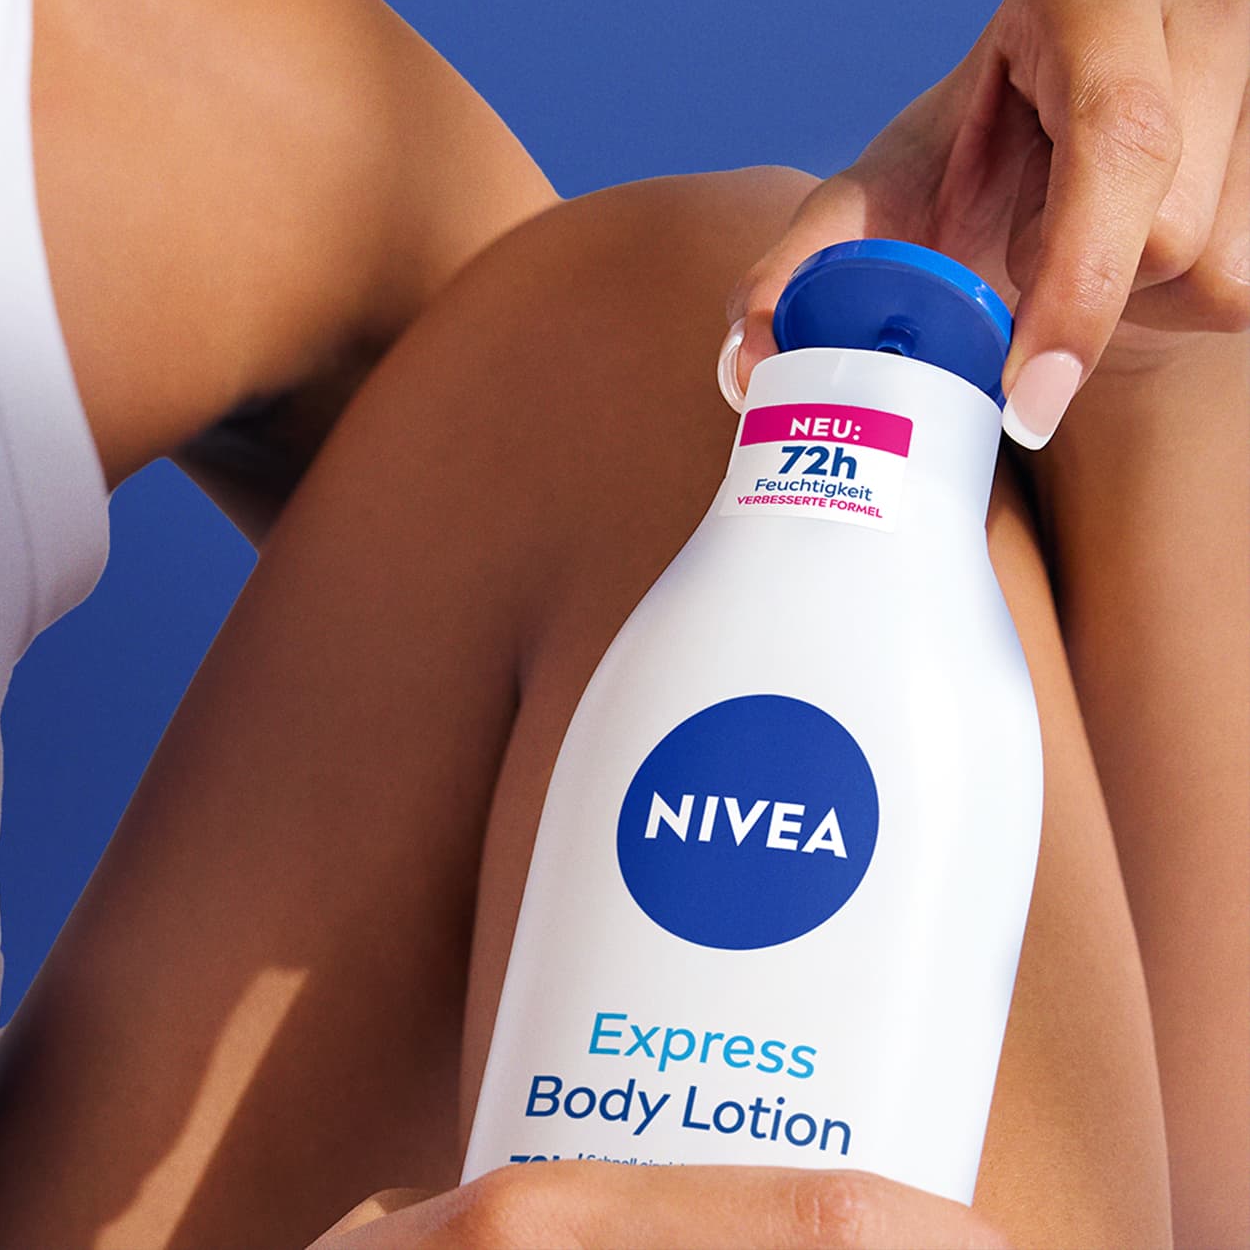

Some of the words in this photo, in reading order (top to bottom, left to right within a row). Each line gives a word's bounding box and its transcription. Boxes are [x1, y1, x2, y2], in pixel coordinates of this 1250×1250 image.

[789, 417, 862, 441] NEU:
[778, 445, 858, 480] 72h
[737, 495, 827, 508] VERBESSERTE
[829, 499, 883, 519] FORMEL
[754, 478, 873, 502] Feuchtigkeit
[644, 791, 848, 859] NIVEA
[588, 1012, 817, 1079] Express
[524, 1075, 671, 1136] Body
[681, 1085, 852, 1156] Lotion
